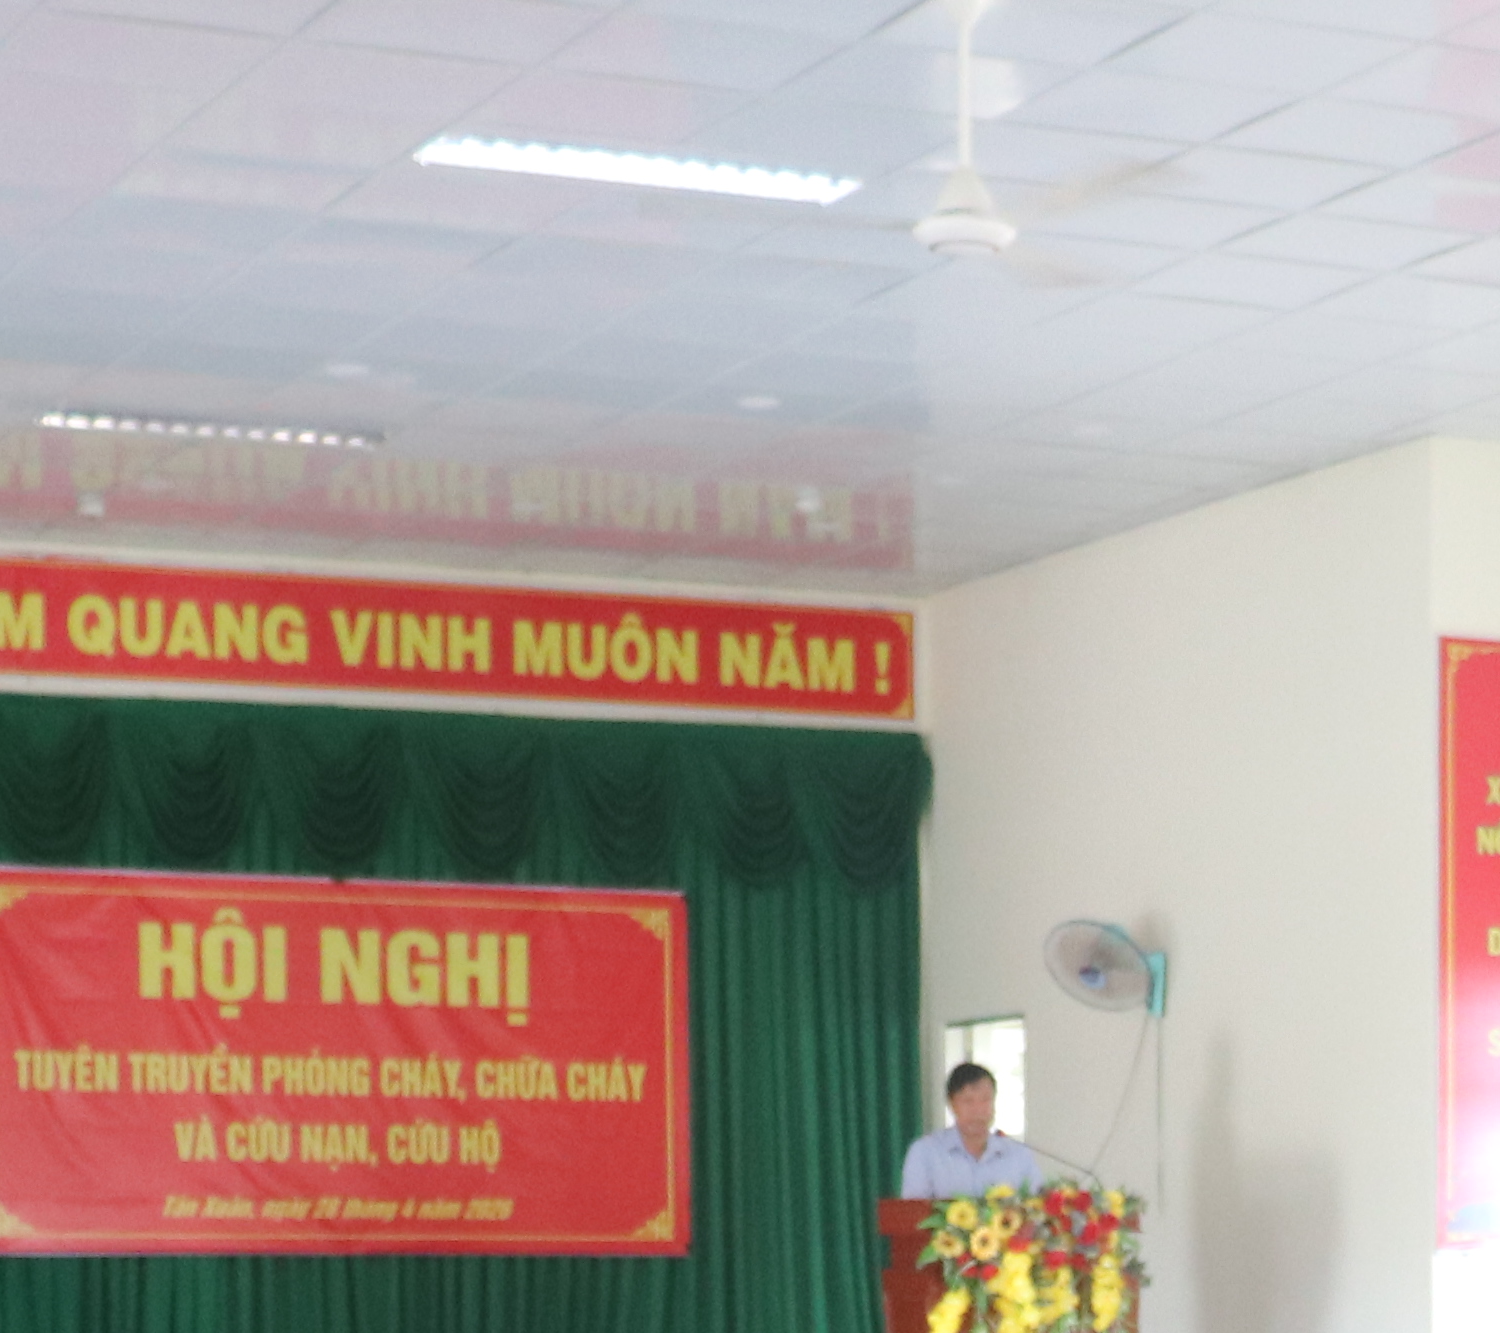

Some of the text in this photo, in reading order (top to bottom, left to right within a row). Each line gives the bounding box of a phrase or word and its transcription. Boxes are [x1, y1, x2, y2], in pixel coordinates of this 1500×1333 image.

[67, 594, 309, 665] QUANG
[330, 608, 492, 674] VINH
[512, 612, 699, 684] MUÔN
[719, 621, 855, 693] NĂM
[138, 908, 530, 1027] HỘI NGHỊ
[13, 1042, 646, 1103] TUYÊN TRUYỀN PHÒNG CHÁY, CHỮA CHÁY
[174, 1114, 500, 1173] VÀ CỨU NẠN, CỨU HỘ
